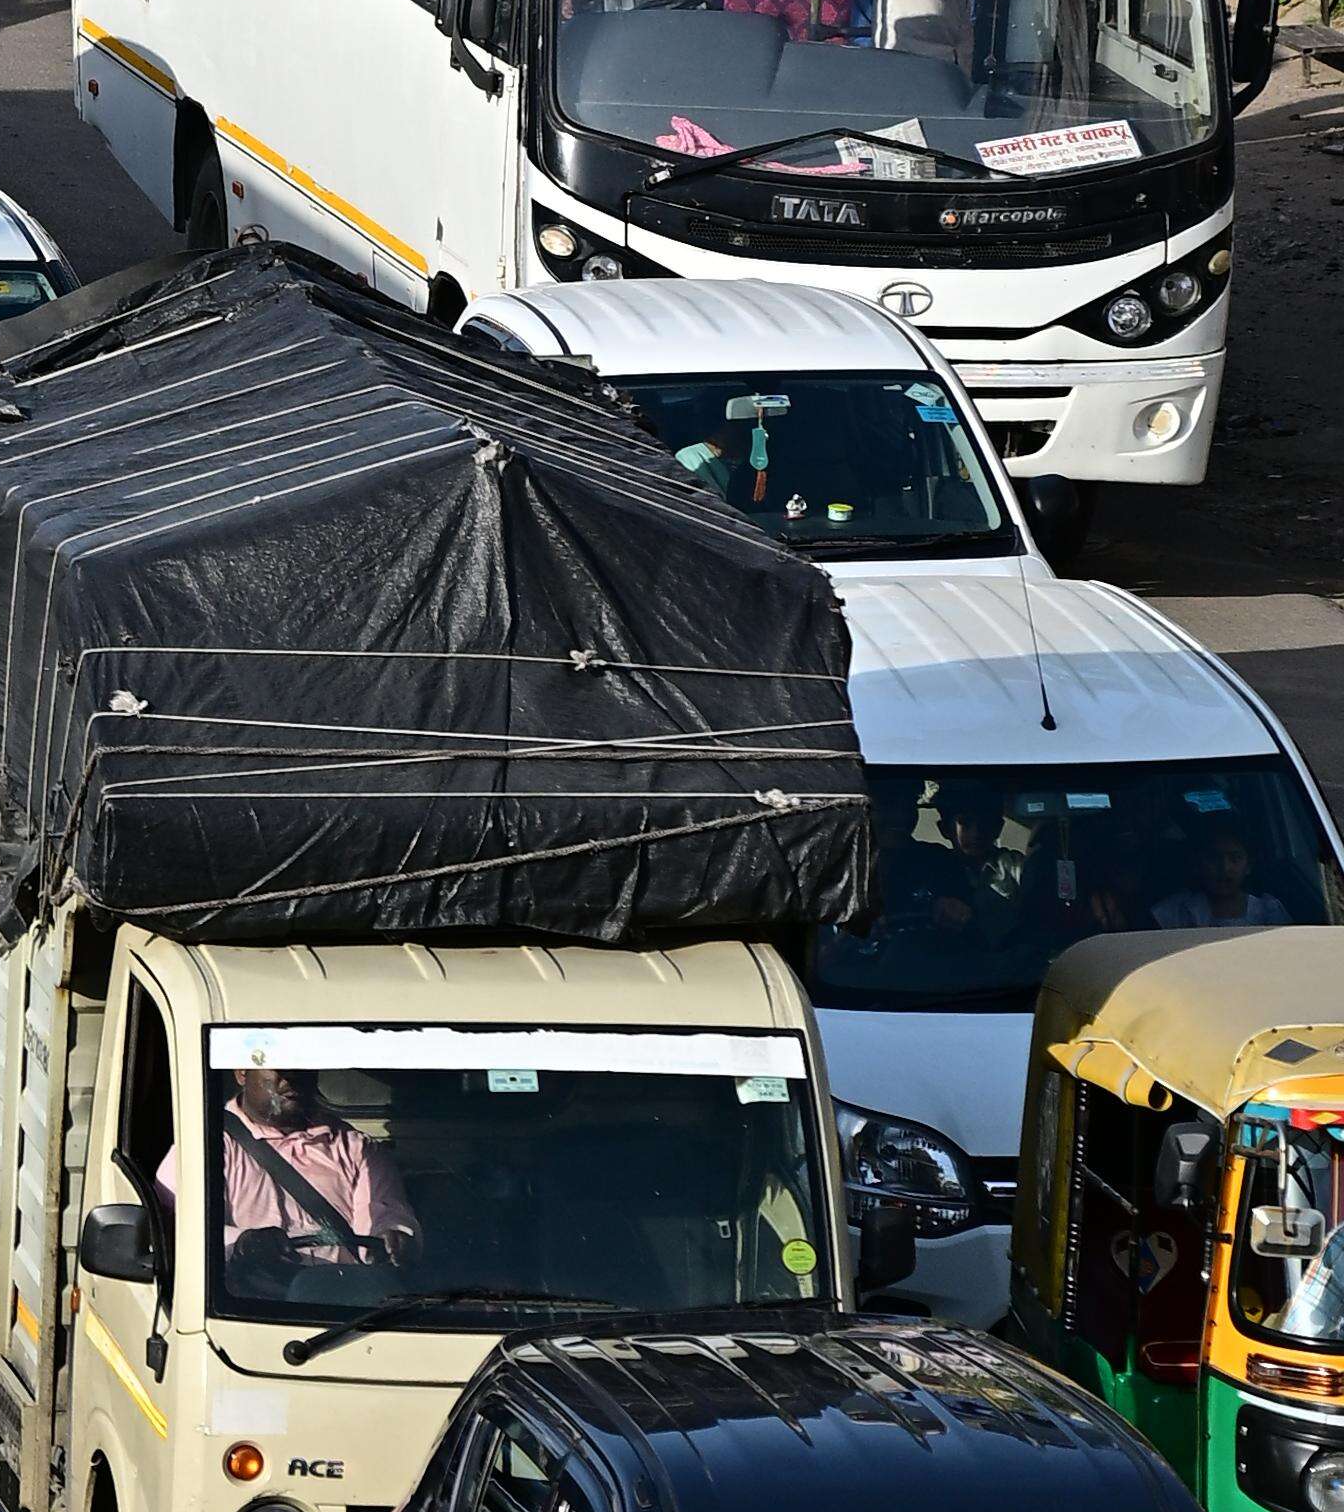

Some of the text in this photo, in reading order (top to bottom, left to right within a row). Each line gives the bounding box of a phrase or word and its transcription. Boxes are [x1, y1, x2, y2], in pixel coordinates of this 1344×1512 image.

[980, 138, 1036, 158] अजमेरी
[780, 196, 862, 224] TATA
[287, 1457, 345, 1480] ACE
